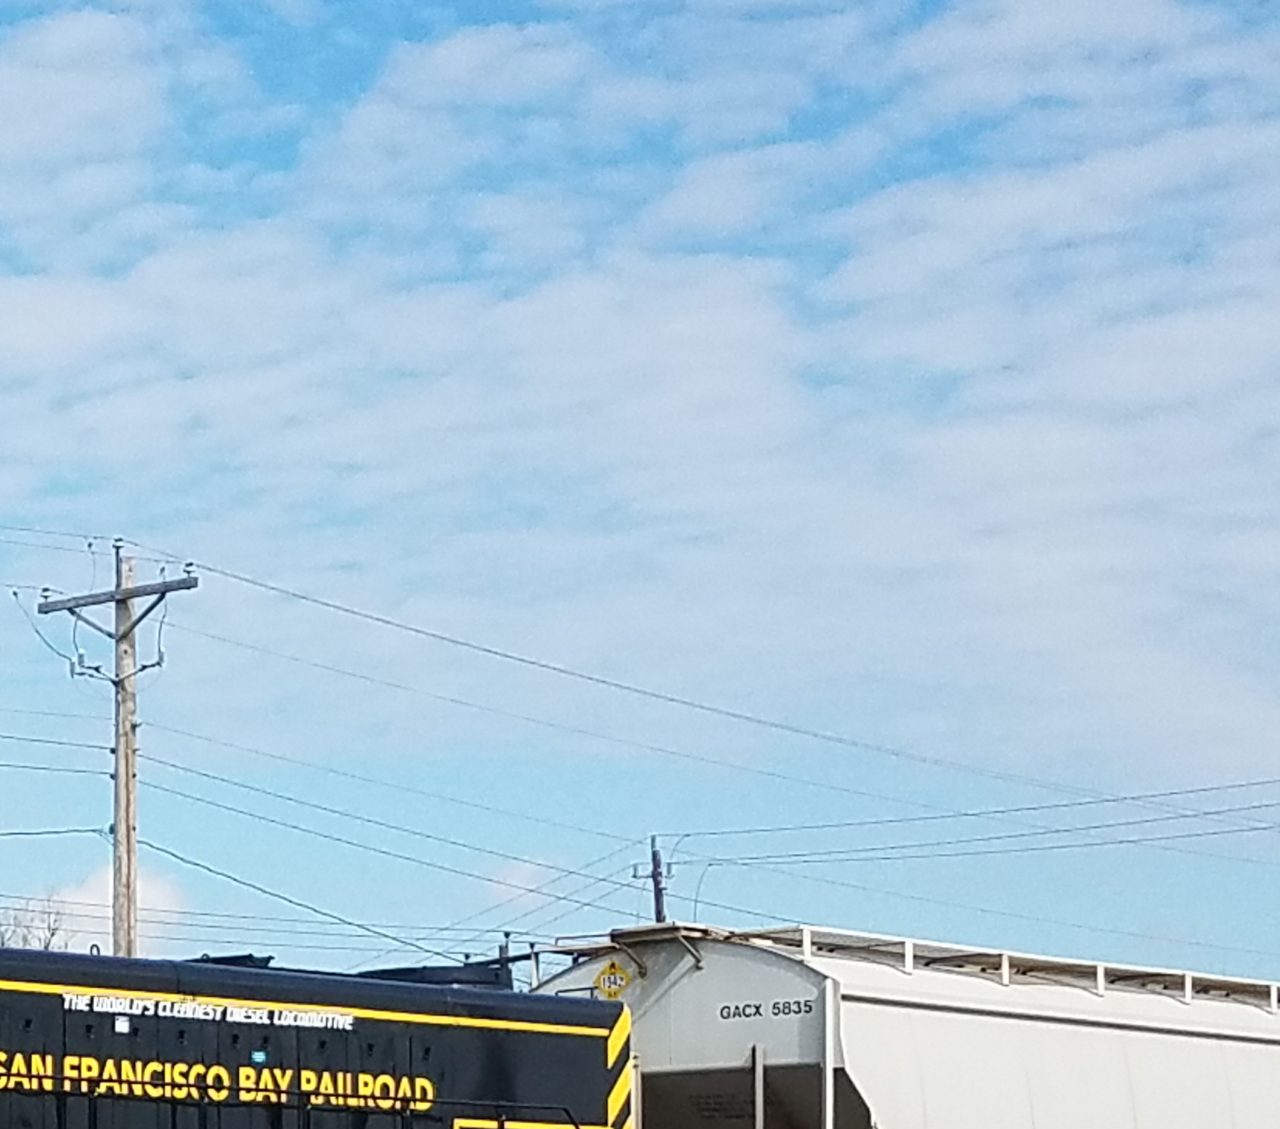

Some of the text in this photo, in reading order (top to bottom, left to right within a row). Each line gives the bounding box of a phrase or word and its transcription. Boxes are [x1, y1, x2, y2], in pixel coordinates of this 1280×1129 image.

[62, 993, 91, 1011] THE
[92, 996, 155, 1016] WORLD'S
[225, 1006, 270, 1024] DIESEL
[273, 1010, 354, 1030] LOCOMOTIVE
[720, 1000, 813, 1019] GACX 5835
[63, 1056, 230, 1102] FRANCISCO
[238, 1066, 294, 1103] BAY
[300, 1069, 434, 1112] RAILROAD
